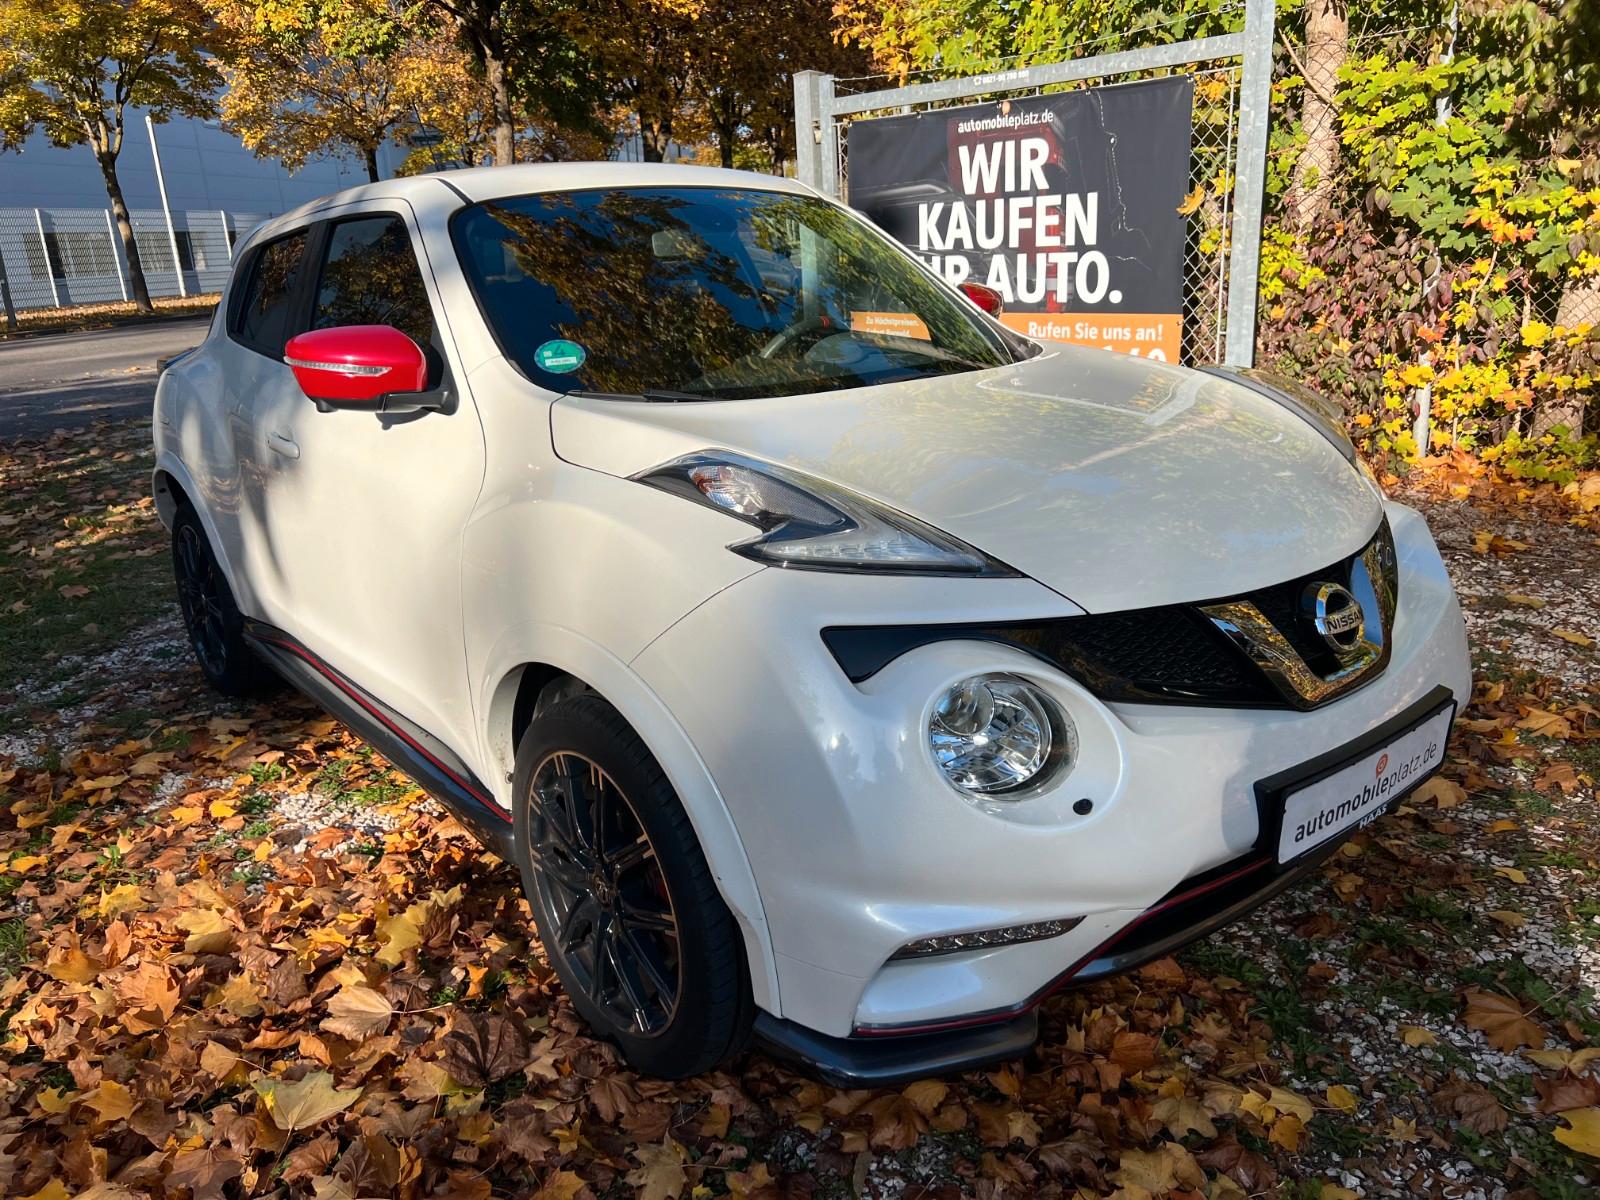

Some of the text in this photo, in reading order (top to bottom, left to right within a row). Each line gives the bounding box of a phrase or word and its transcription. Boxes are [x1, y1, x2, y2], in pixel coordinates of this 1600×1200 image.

[958, 109, 1054, 134] automobileplatz.de
[958, 137, 1050, 195] WIR
[918, 192, 1099, 251] KAUFEN
[985, 250, 1123, 304] AUTO.
[1028, 321, 1163, 341] Rufen Sie uns an!
[1294, 741, 1437, 843] automobileplatz.de
